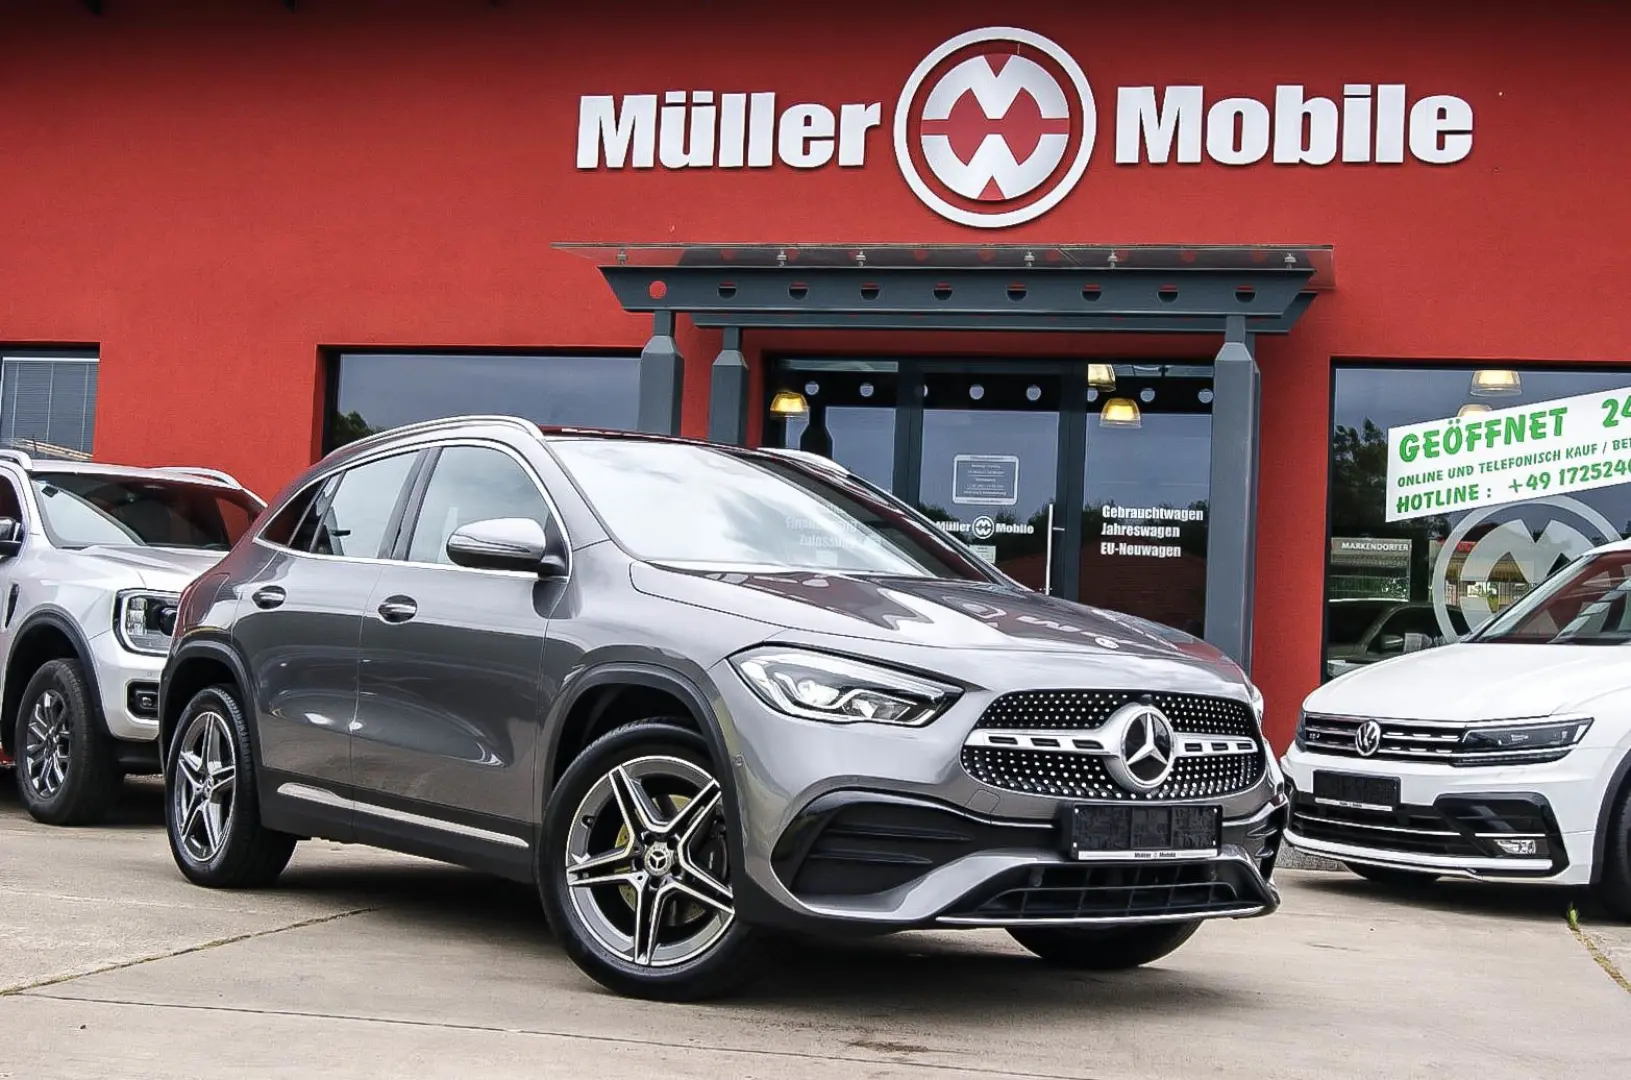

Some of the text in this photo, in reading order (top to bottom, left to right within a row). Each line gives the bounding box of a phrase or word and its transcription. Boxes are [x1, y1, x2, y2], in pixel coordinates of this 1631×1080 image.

[576, 91, 882, 169] Müller
[1115, 83, 1475, 166] Mobile
[1399, 406, 1568, 463] GEÖFFNET
[1397, 470, 1444, 488] ONLINE
[1447, 465, 1475, 480] UND
[1478, 449, 1561, 474] TELEFONISCH
[1565, 443, 1598, 460] KAUF
[1612, 437, 1631, 451] BE
[1396, 483, 1480, 514] HOTLINE
[1508, 471, 1552, 494] +49
[1102, 504, 1204, 522] Gebrauchtwagen
[996, 522, 1035, 535] Mobile
[1100, 522, 1181, 539] Jahreswagen
[1100, 541, 1182, 558] EU-Neuwagen
